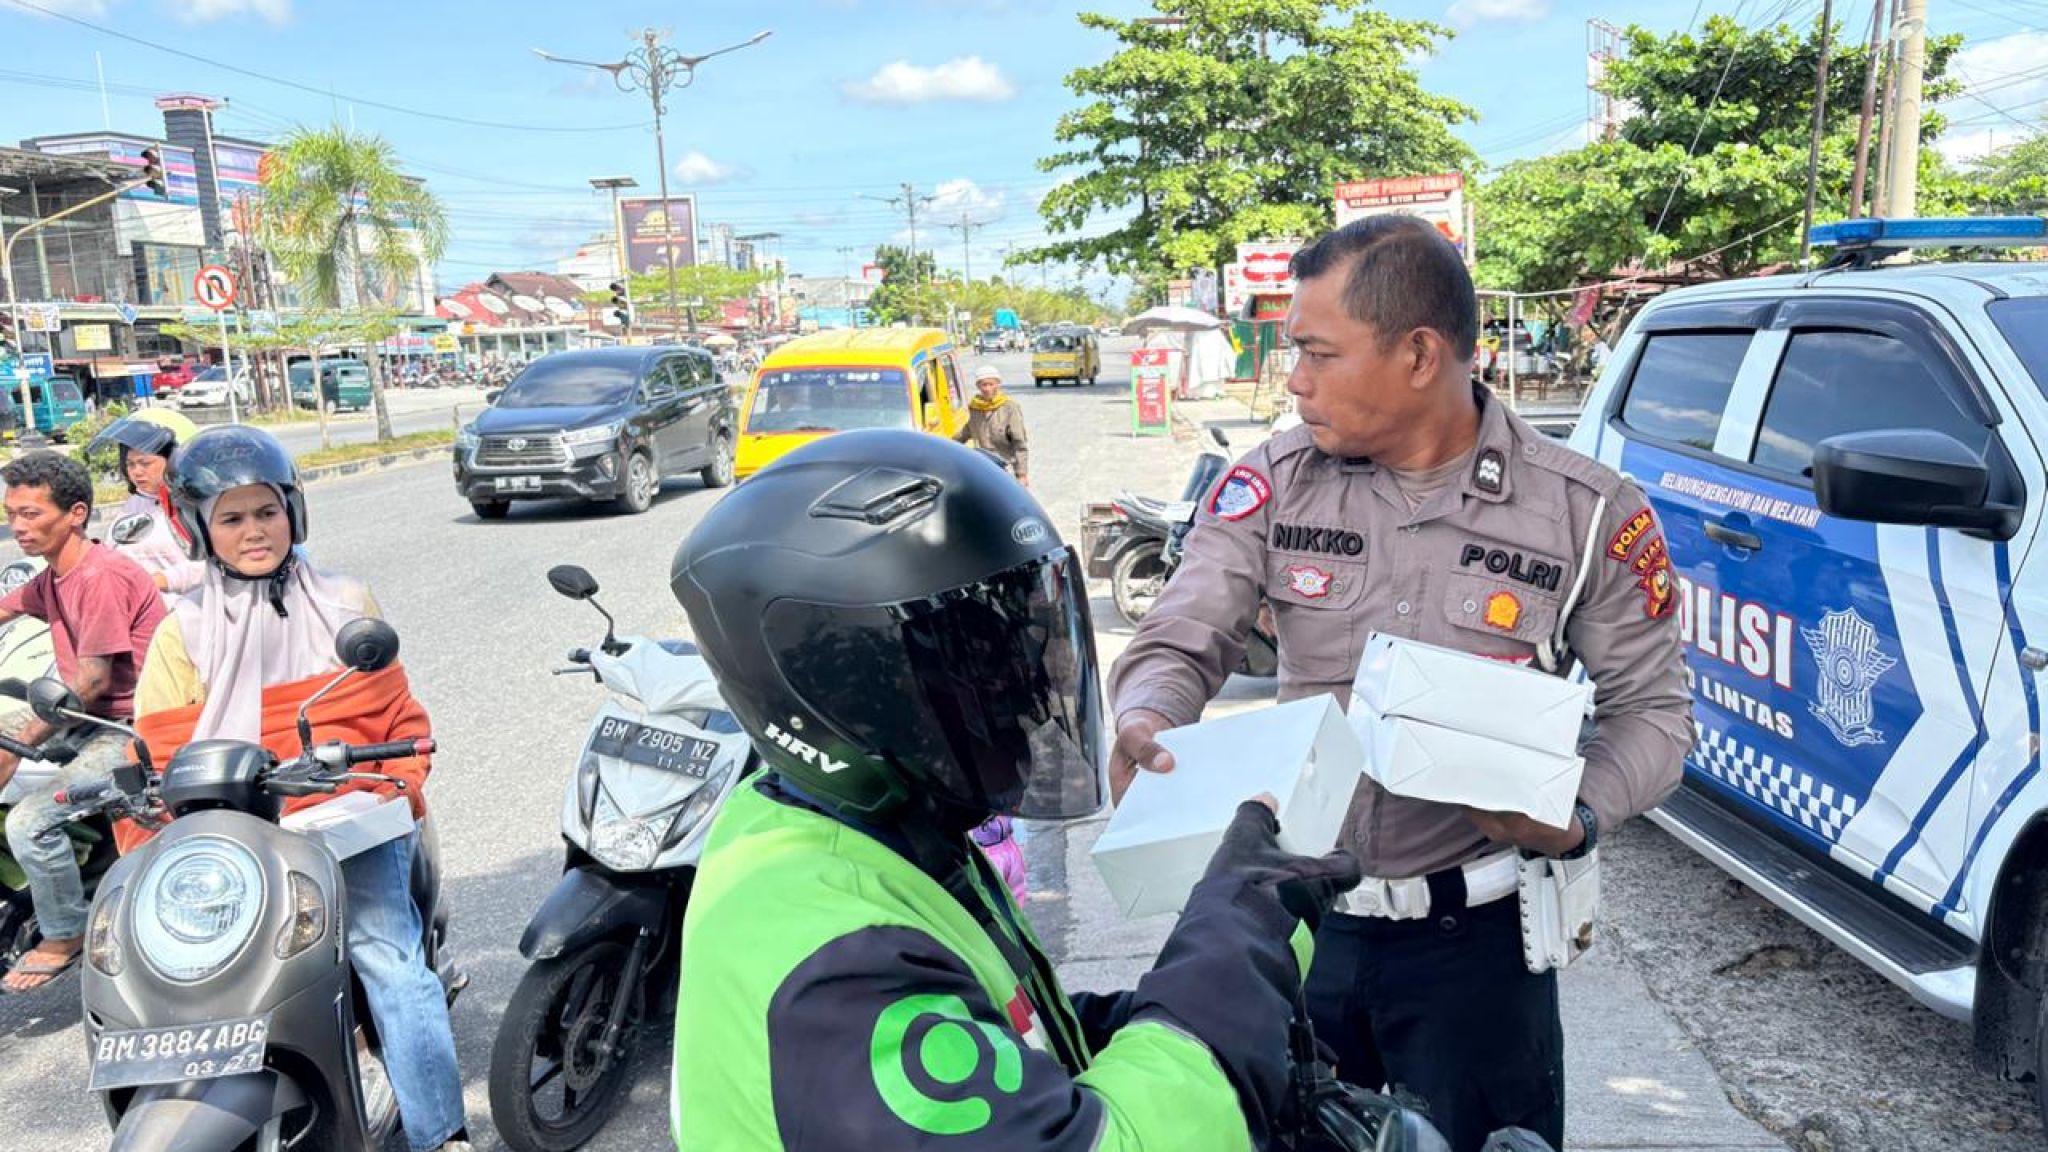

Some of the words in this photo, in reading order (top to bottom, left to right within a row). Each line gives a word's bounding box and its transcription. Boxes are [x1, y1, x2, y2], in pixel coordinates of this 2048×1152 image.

[1751, 495, 1771, 516] DAN
[1770, 499, 1822, 529] MELAYANI
[1272, 522, 1364, 556] NIKKO
[1613, 513, 1651, 556] POLDA
[1460, 543, 1562, 592] POLRI
[1680, 577, 1792, 690] OLISI
[1701, 675, 1794, 739] LINTAS
[602, 719, 629, 741] BM
[637, 728, 686, 754] 2905
[691, 741, 717, 761] NZ
[764, 722, 850, 774] HRV
[97, 1035, 138, 1063] BM
